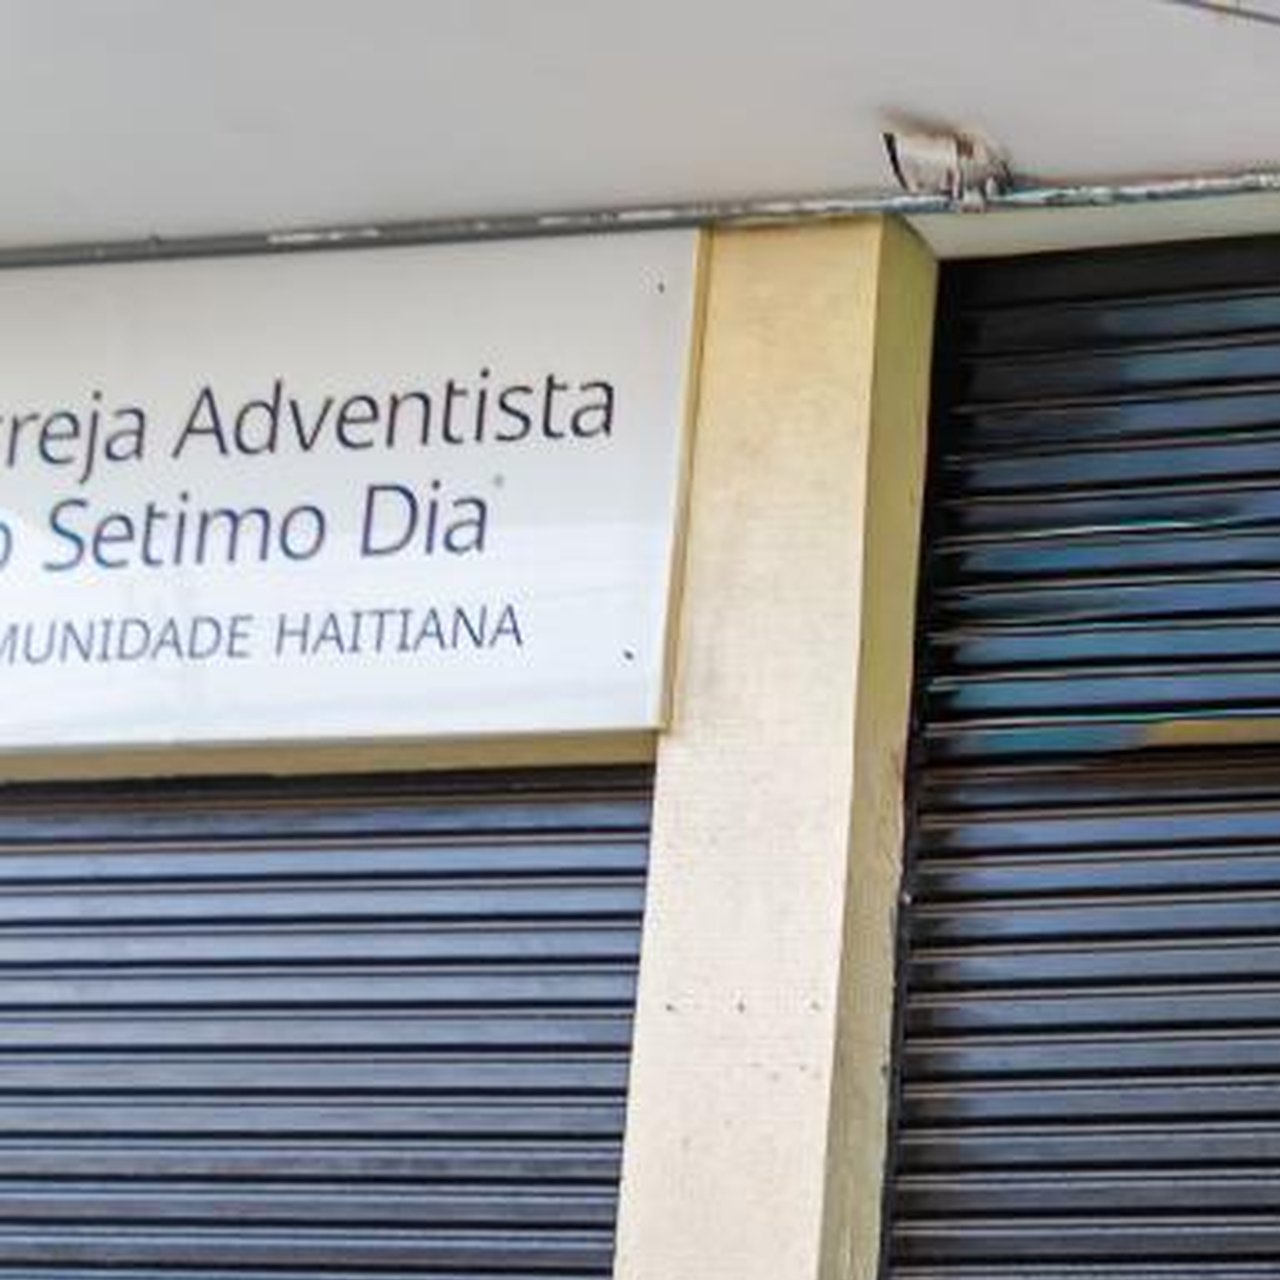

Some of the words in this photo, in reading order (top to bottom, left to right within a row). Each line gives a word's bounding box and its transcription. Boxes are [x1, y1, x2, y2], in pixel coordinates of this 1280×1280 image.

[0, 388, 147, 486] reja
[170, 366, 615, 461] Adventista
[42, 490, 328, 574] Setimo
[359, 478, 489, 559] Dia
[274, 603, 526, 658] HAITIANA
